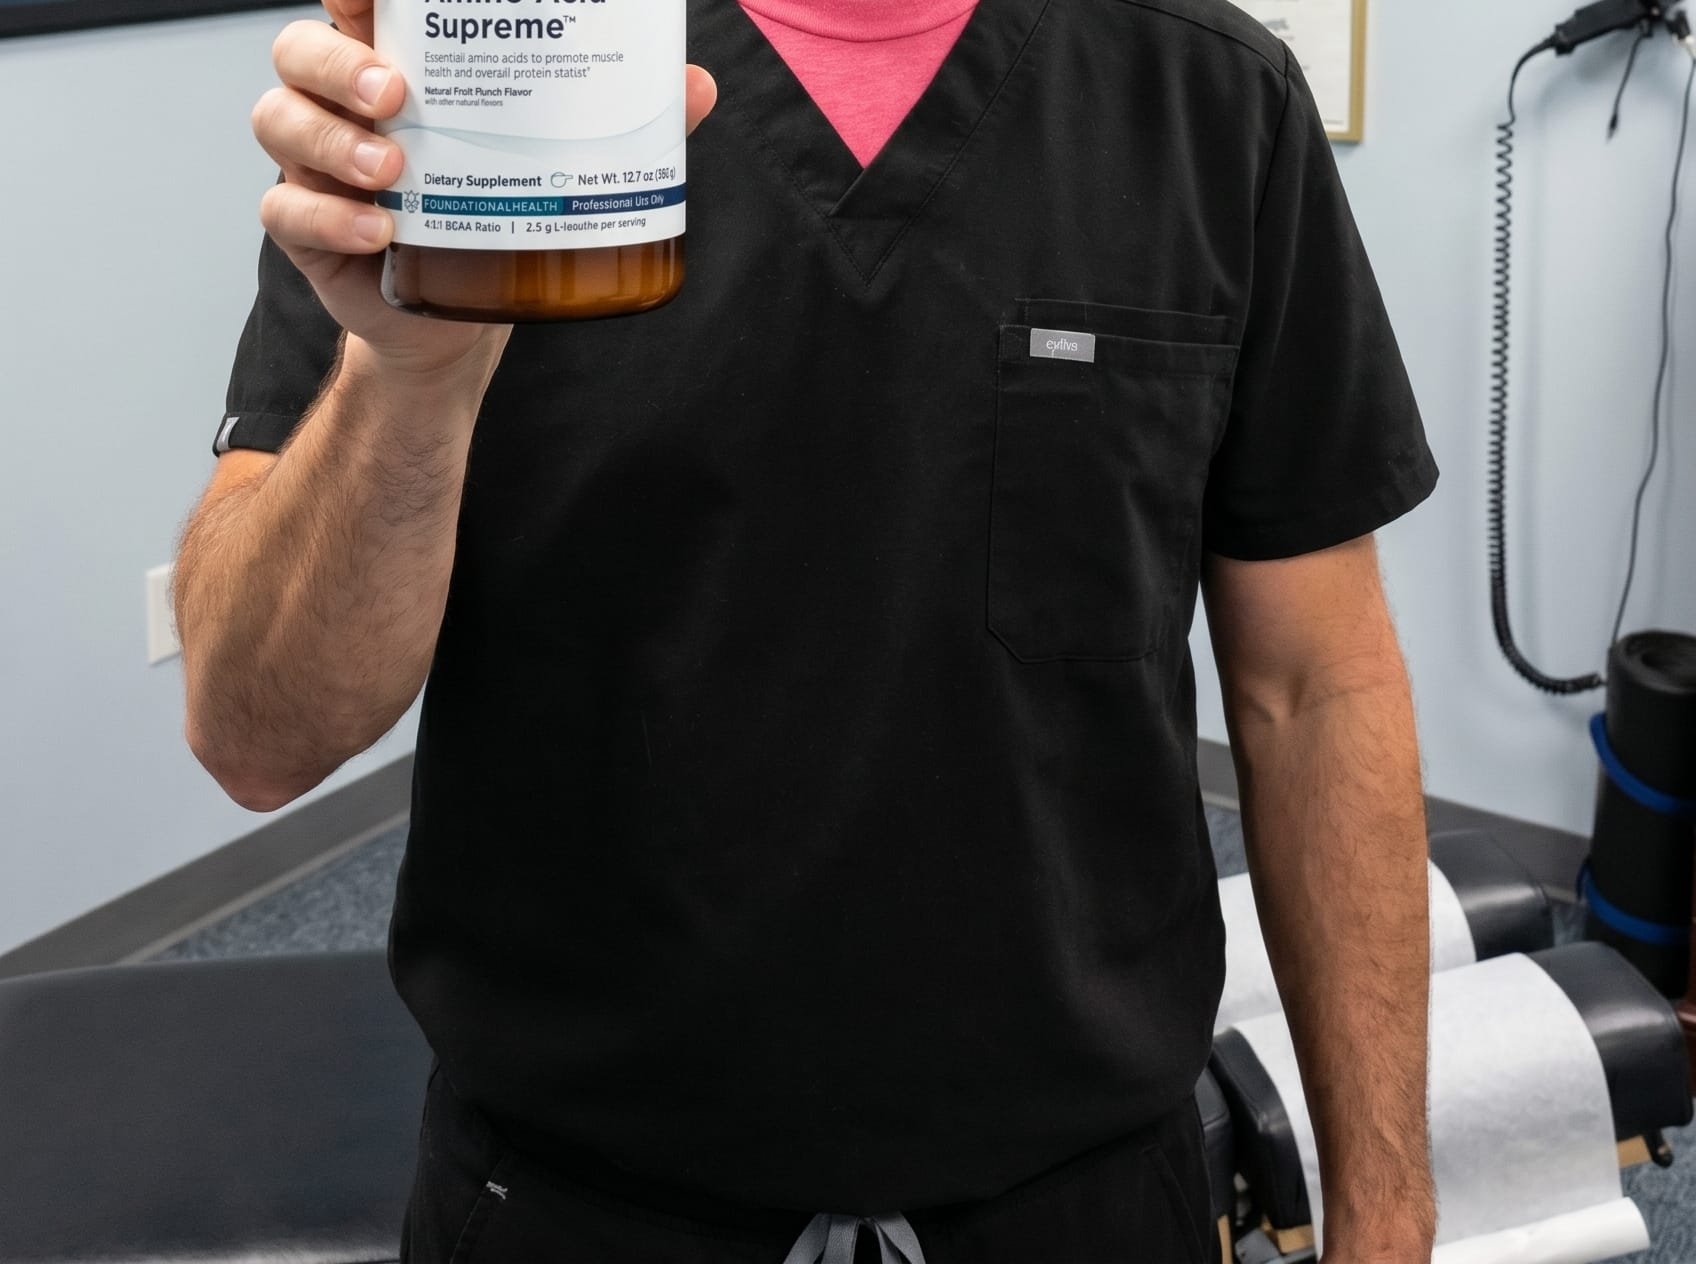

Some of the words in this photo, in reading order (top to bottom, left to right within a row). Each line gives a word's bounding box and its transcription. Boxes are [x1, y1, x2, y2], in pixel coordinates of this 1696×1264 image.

[467, 52, 499, 64] amino
[501, 51, 528, 64] acids
[531, 54, 542, 64] to
[545, 52, 589, 66] promote
[591, 51, 624, 63] muscle
[424, 66, 452, 78] health
[454, 67, 473, 78] and
[513, 67, 551, 80] protein
[504, 87, 533, 97] Flavor
[424, 173, 463, 188] Dietary
[466, 175, 542, 189] Supplement
[578, 173, 599, 186] Net
[601, 172, 621, 185] Wt.
[622, 170, 642, 184] 12.7
[643, 171, 654, 182] oz
[445, 220, 473, 232] BCAA
[475, 221, 501, 233] Ratio
[526, 222, 543, 233] 2.5
[545, 225, 552, 235] g
[600, 221, 616, 232] per
[618, 217, 646, 228] serving
